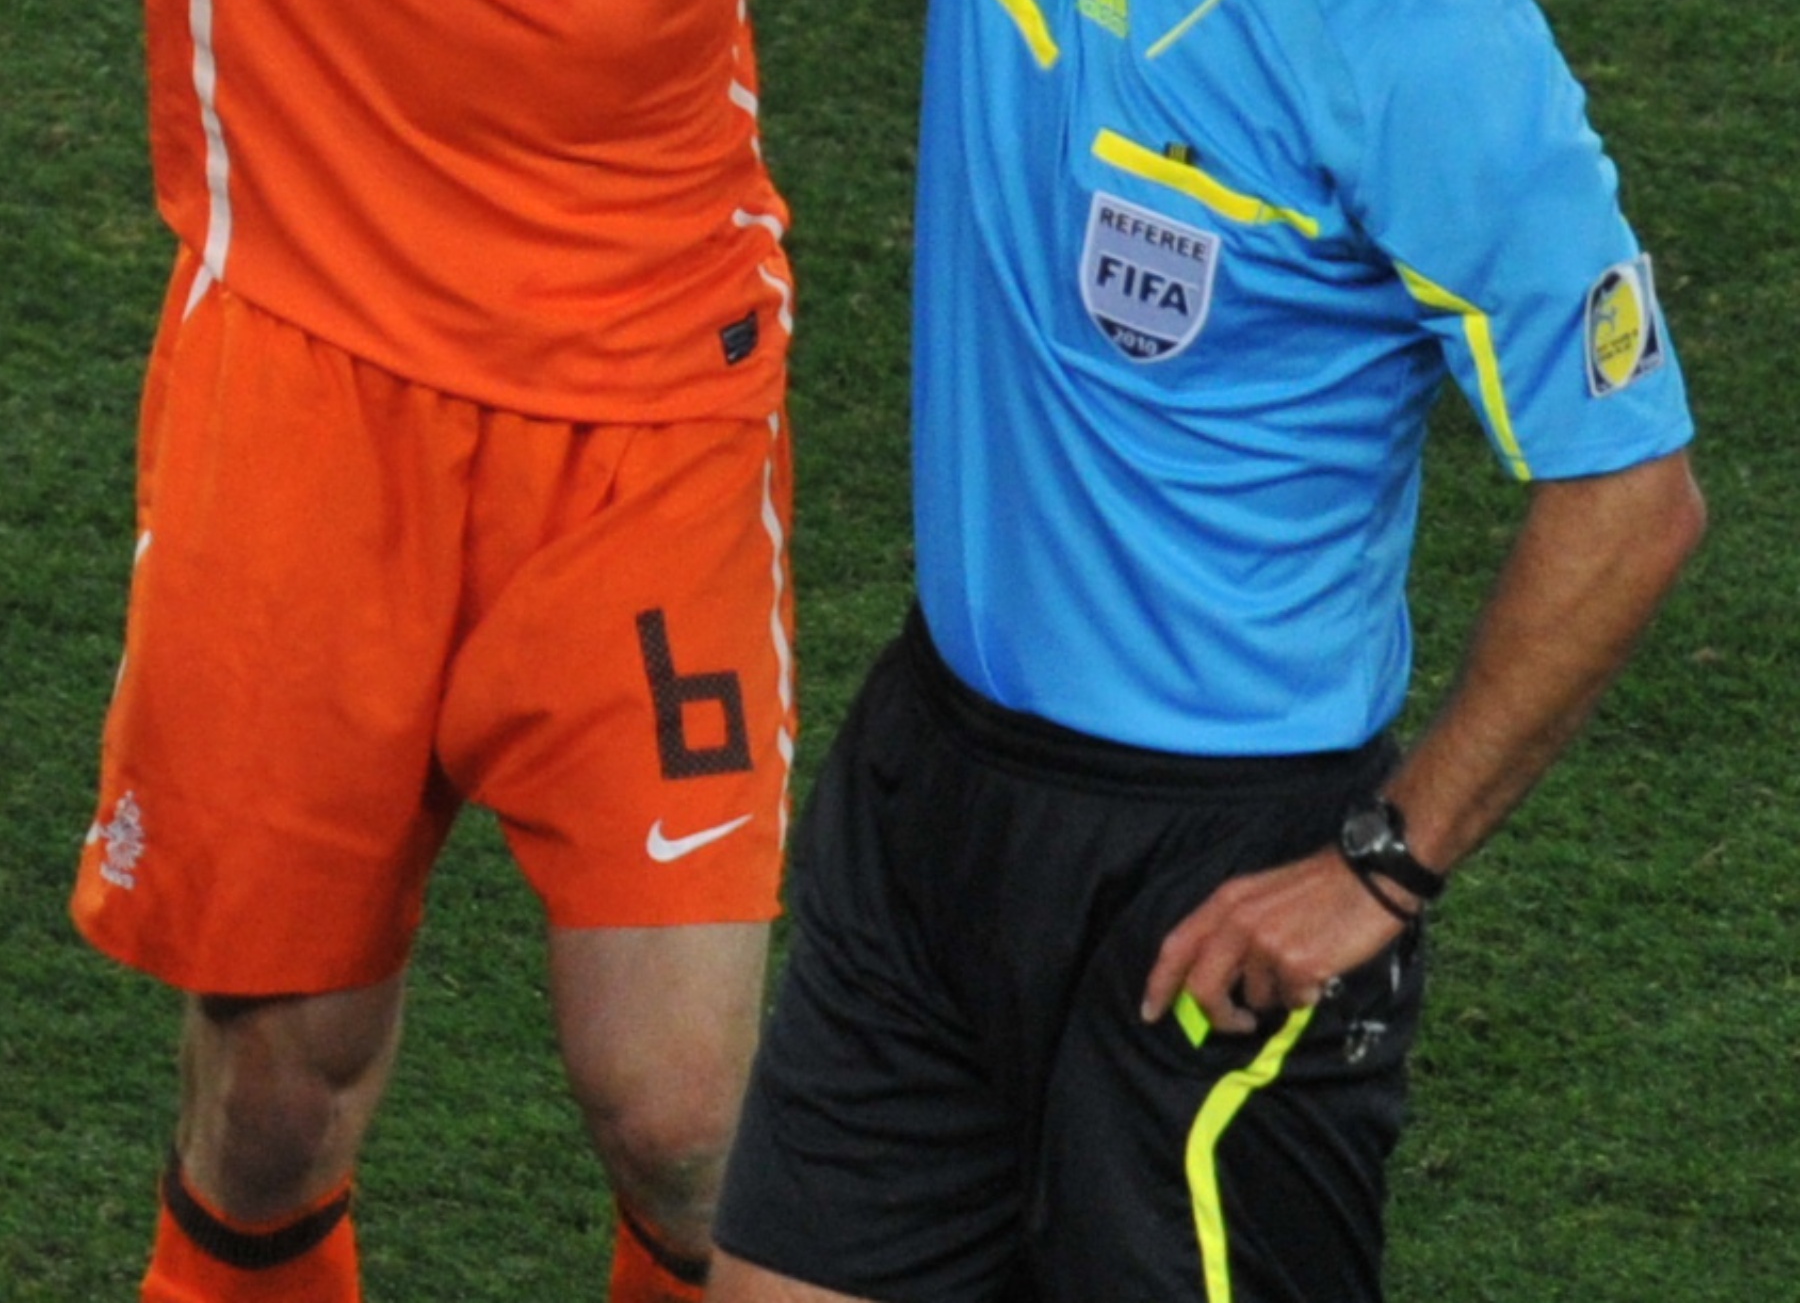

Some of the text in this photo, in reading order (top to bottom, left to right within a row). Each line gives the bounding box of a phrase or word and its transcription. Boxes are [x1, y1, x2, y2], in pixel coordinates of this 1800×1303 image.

[1099, 206, 1207, 263] REFEREE
[1096, 254, 1189, 317] FIFA
[1112, 328, 1158, 357] 2010
[636, 608, 754, 780] 6
